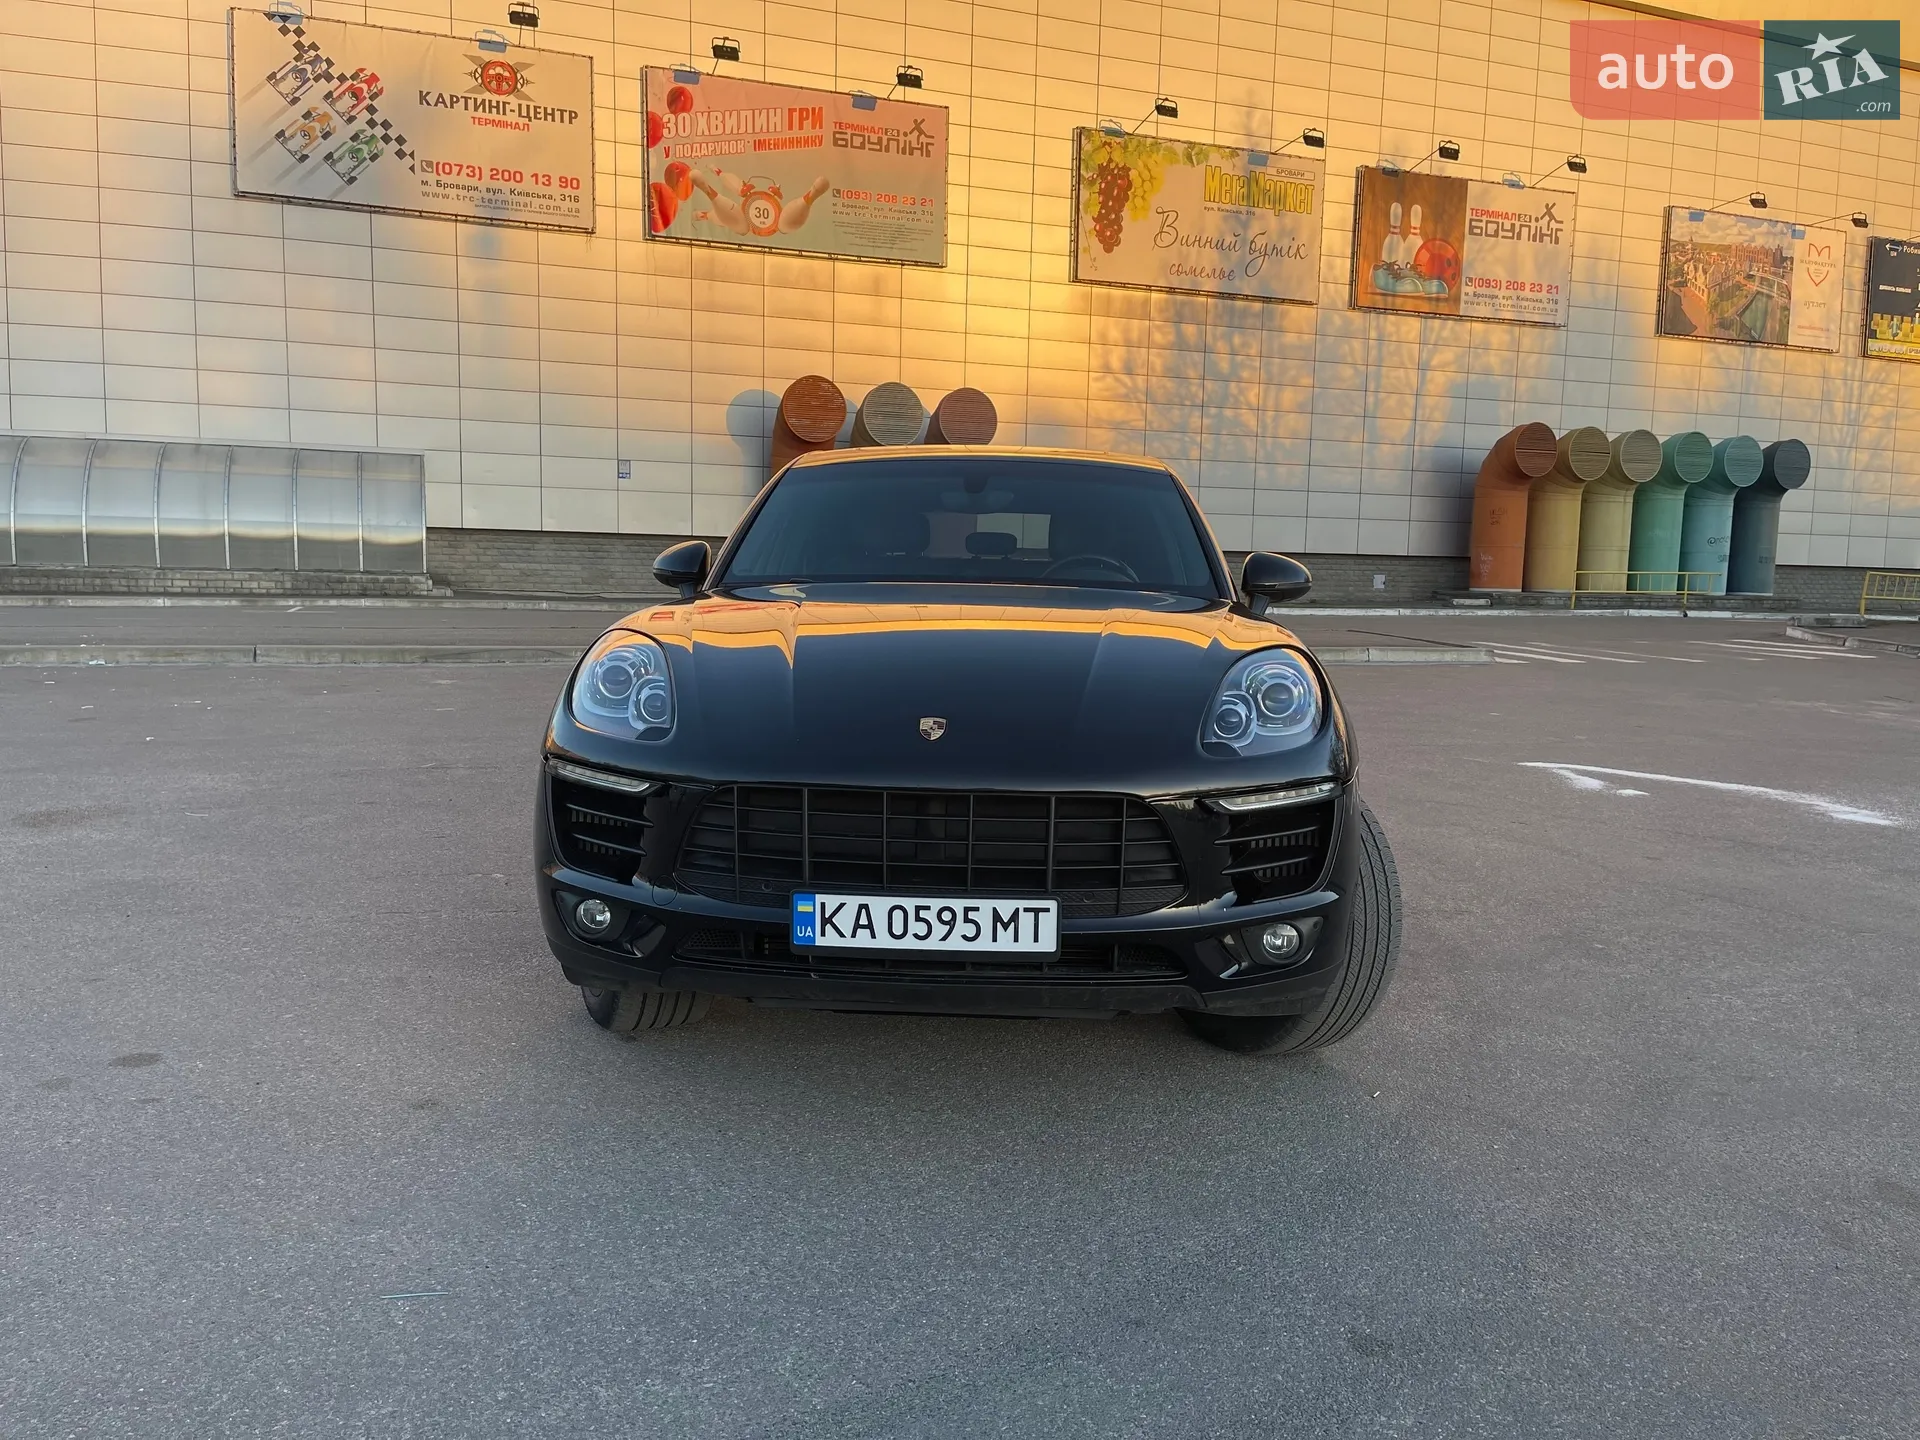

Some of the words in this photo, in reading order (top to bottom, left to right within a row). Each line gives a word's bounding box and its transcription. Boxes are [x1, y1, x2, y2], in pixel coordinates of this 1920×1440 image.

[418, 89, 579, 125] КАРТИНГ-ЦЕНТР
[470, 116, 530, 132] ТЕРМІНАЛ
[662, 112, 693, 139] 30
[695, 107, 783, 137] ХВИЛИН
[787, 106, 824, 131] ГРИ
[832, 120, 884, 136] ТЕРМІНАЛ
[886, 128, 899, 137] 24
[663, 145, 671, 159] У
[675, 139, 746, 159] ПОДАРУНОК
[753, 134, 824, 152] ІМЕНИННИКУ
[832, 130, 935, 158] БОУЛІНГ
[435, 161, 483, 182] (073)
[489, 167, 524, 184] 200
[530, 172, 552, 187] 13
[558, 175, 581, 191] 90
[1276, 168, 1305, 178] БРОВАРИ
[420, 179, 432, 187] м.
[436, 179, 482, 194] Бровари,
[485, 186, 506, 196] вул.
[509, 187, 557, 203] Київська,
[560, 194, 580, 204] 316
[421, 190, 581, 214] www.trc-terminal.com.ua
[842, 189, 873, 203] (093)
[876, 193, 898, 204] 208
[902, 195, 916, 206] 23
[920, 197, 934, 208] 21
[1203, 164, 1315, 217] МегаМаркет
[754, 206, 770, 220] 30
[1469, 207, 1517, 222] ТЕРМІНАЛ
[1519, 214, 1531, 222] 24
[1152, 206, 1242, 253] Винний
[1244, 230, 1309, 278] бутік
[1468, 218, 1564, 245] БОУЛІНГ
[1169, 262, 1237, 282] сомельє
[1474, 277, 1502, 291] (093)
[1505, 280, 1526, 292] 208
[1529, 282, 1543, 293] 23
[1546, 284, 1559, 295] 21
[797, 926, 814, 938] UA
[820, 901, 877, 940] KA
[887, 904, 982, 942] 0595
[991, 906, 1051, 943] MT
